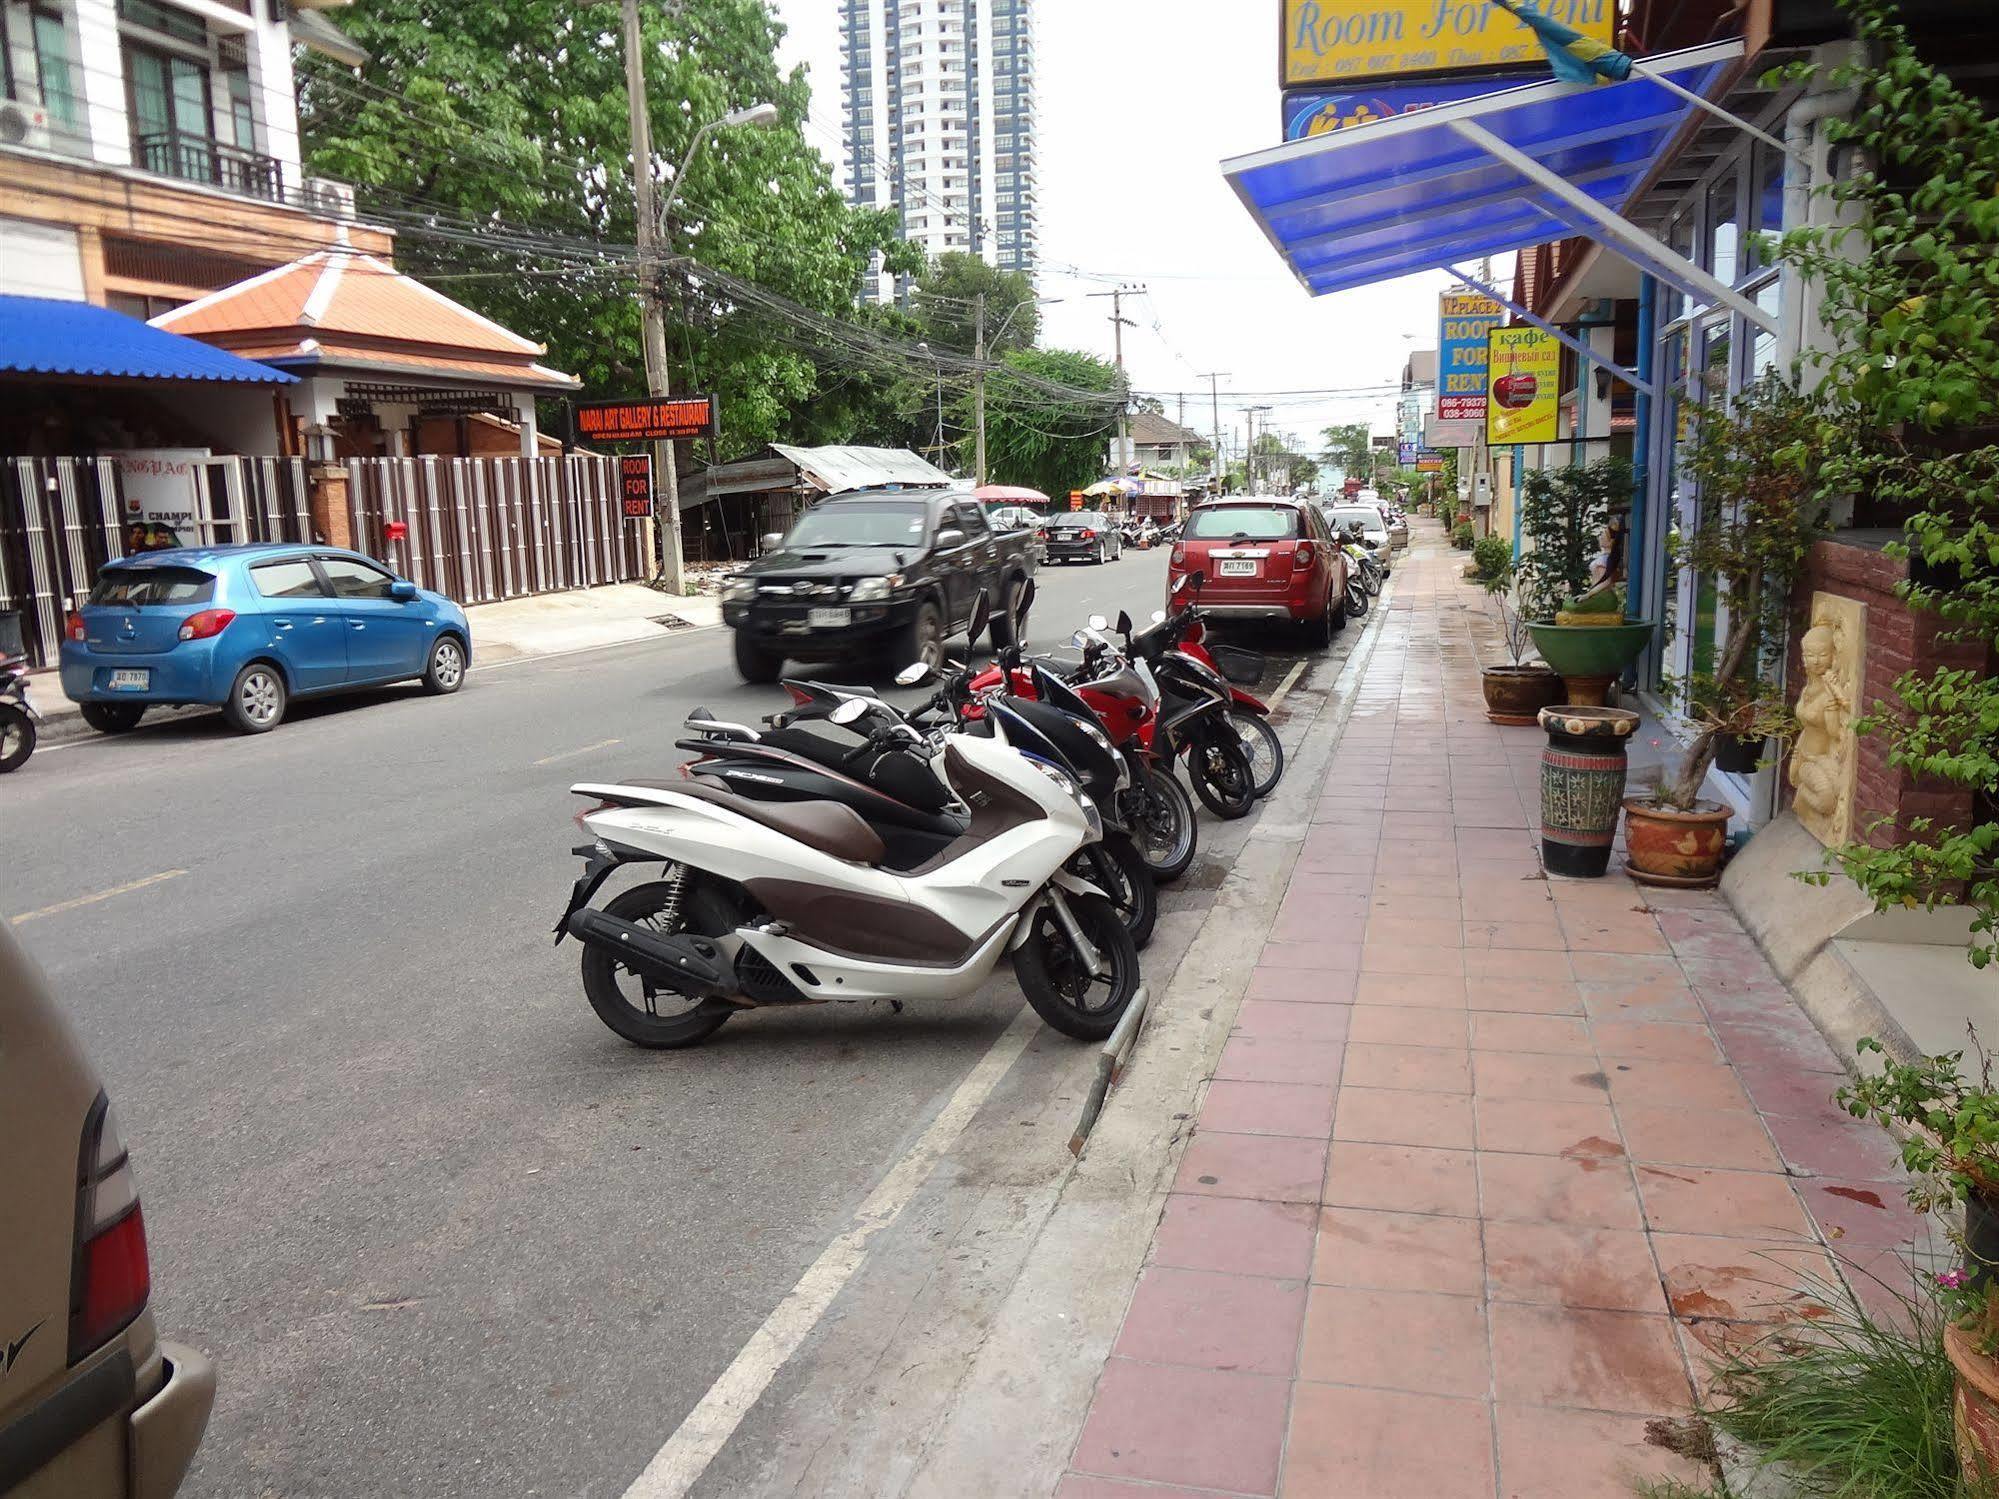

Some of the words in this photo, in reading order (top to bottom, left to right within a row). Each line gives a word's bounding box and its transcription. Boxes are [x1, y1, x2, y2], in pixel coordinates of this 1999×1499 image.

[1293, 0, 1405, 57] Room
[1421, 0, 1494, 39] For
[1499, 329, 1549, 348] кафе
[1452, 347, 1488, 366] FOR
[579, 408, 603, 432] NARAI
[604, 407, 619, 431] ART
[619, 405, 651, 430] GALLERY
[660, 403, 710, 427] RESTAURANT
[622, 459, 648, 475] ROOM
[626, 479, 647, 495] FOR
[625, 499, 650, 515] RENT
